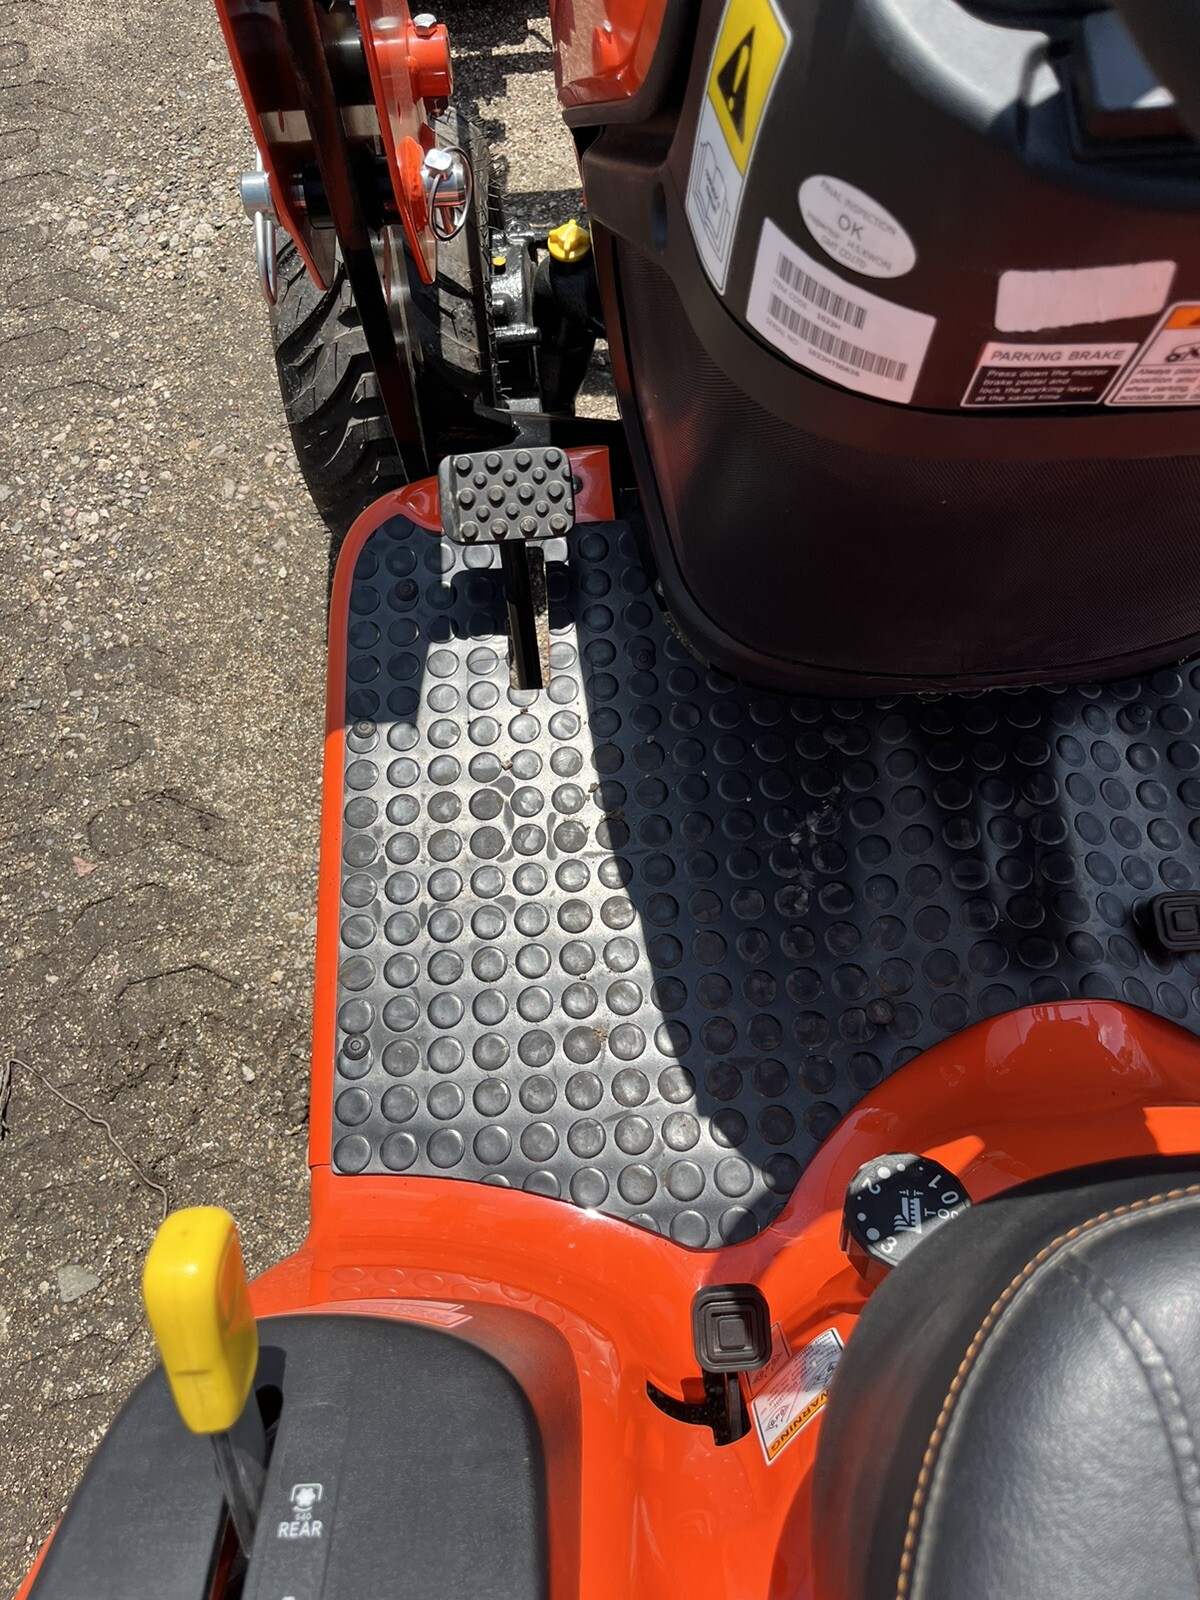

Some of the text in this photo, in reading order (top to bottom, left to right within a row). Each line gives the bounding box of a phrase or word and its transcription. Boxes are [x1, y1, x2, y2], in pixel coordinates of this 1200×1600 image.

[838, 214, 864, 241] OK
[990, 350, 1125, 362] PARKING BRAKE
[861, 1178, 881, 1195] 2
[928, 1174, 942, 1189] 1
[941, 1190, 959, 1204] 0
[880, 1236, 897, 1254] 3
[277, 1520, 322, 1539] REAR
